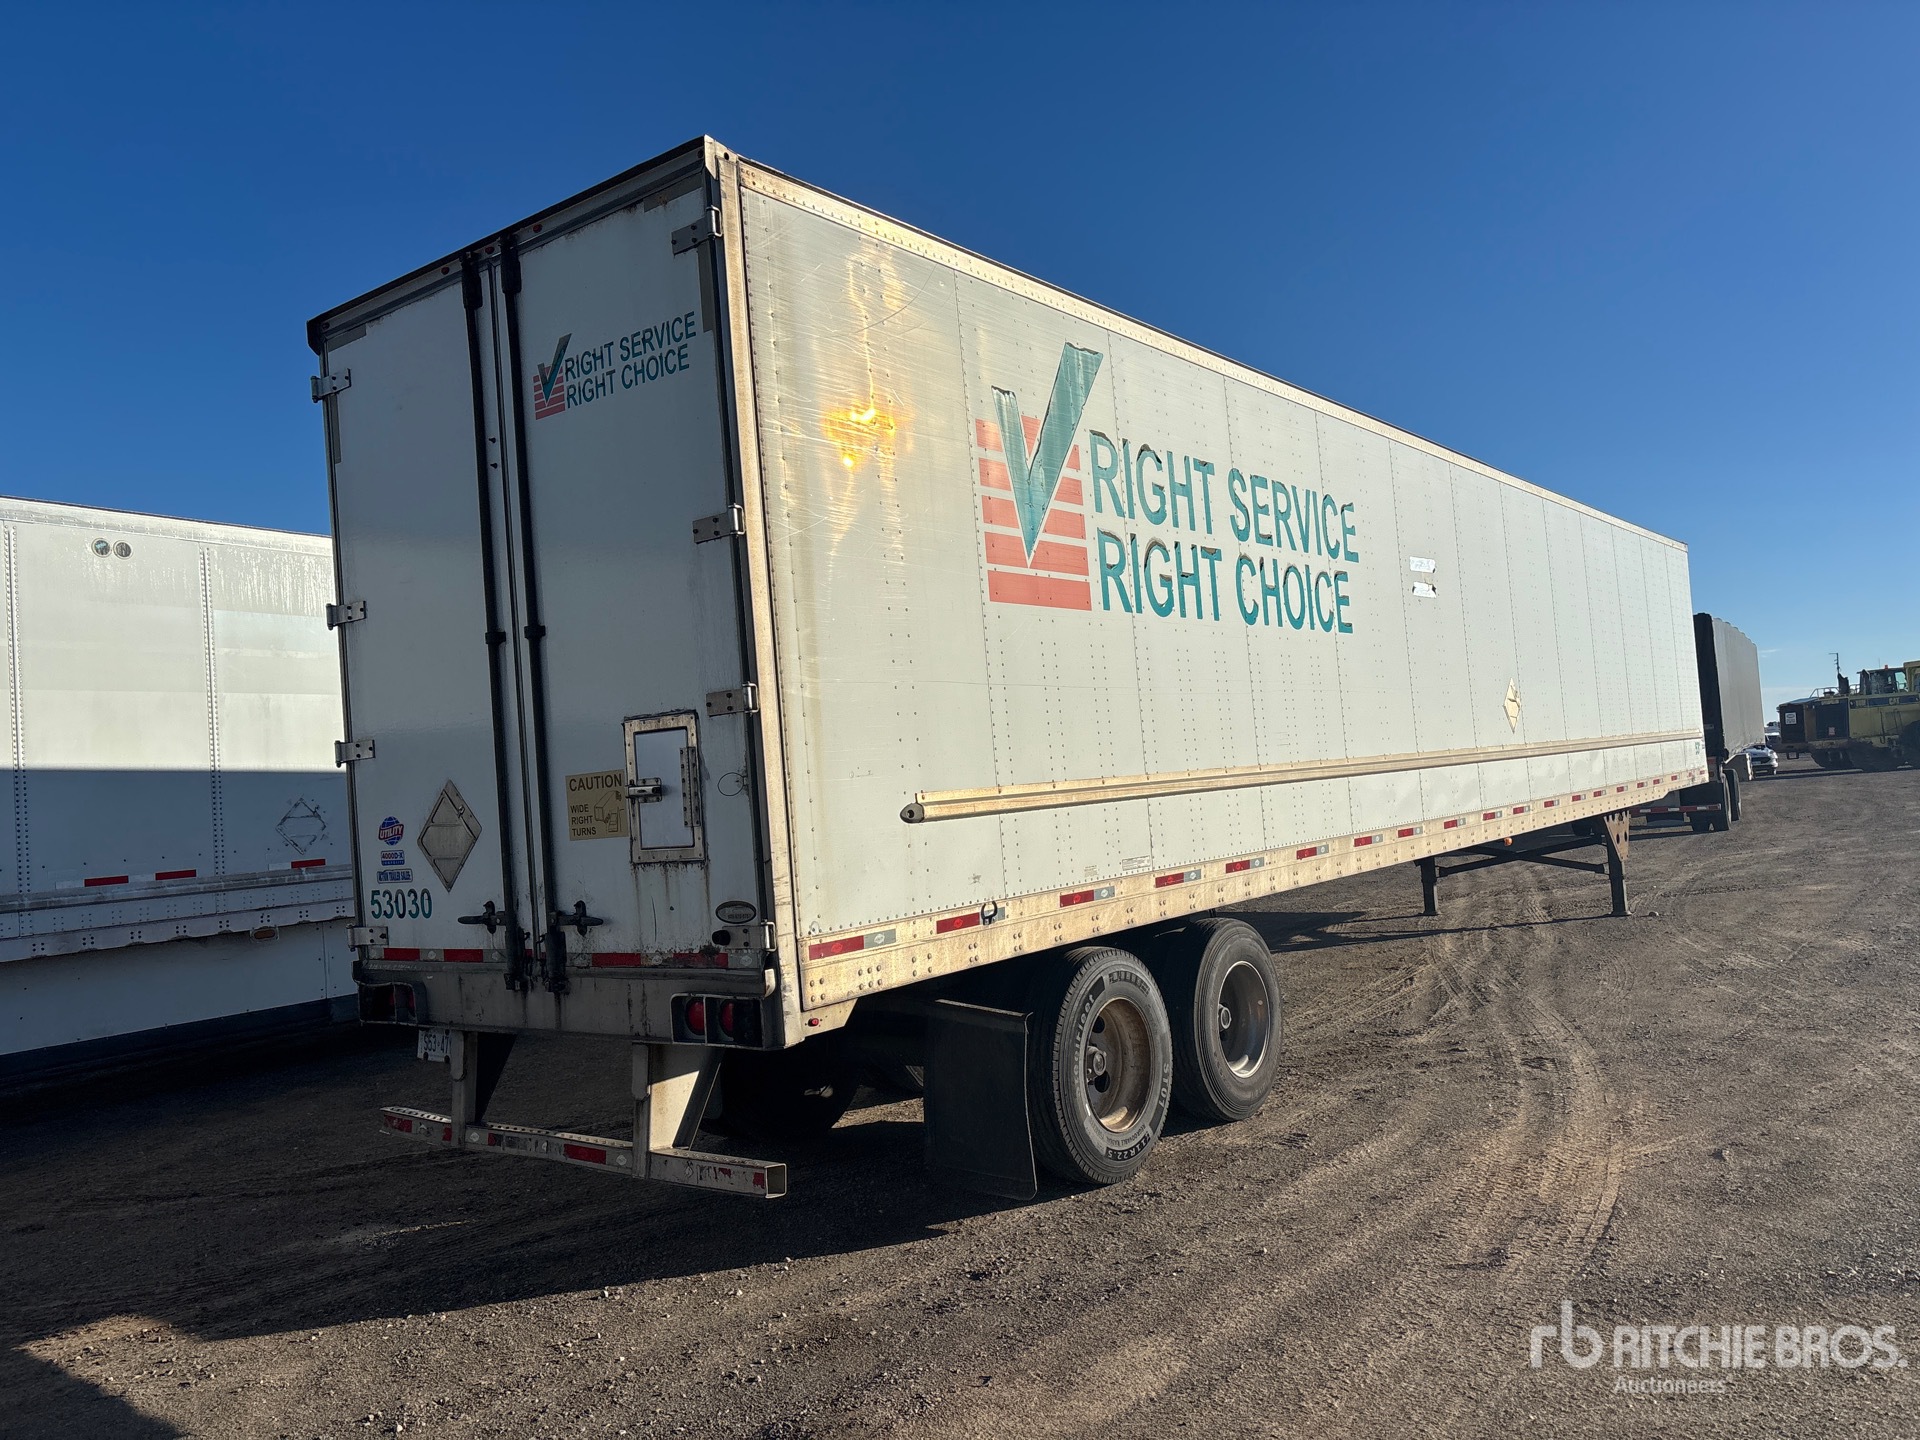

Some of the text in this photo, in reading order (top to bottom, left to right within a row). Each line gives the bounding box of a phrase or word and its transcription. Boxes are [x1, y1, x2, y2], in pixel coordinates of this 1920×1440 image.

[565, 311, 696, 382] RIGHT SERVICE
[567, 344, 690, 409] RIGHT CHOICE
[1090, 429, 1359, 563] RIGHT SERVICE
[1097, 528, 1353, 633] RIGHT CHOICE
[569, 774, 622, 791] CAUTION
[570, 804, 589, 813] WIDE
[571, 815, 593, 825] RIGHT
[380, 825, 403, 839] UTILITY
[572, 827, 596, 837] TURNS
[371, 888, 432, 919] 53030
